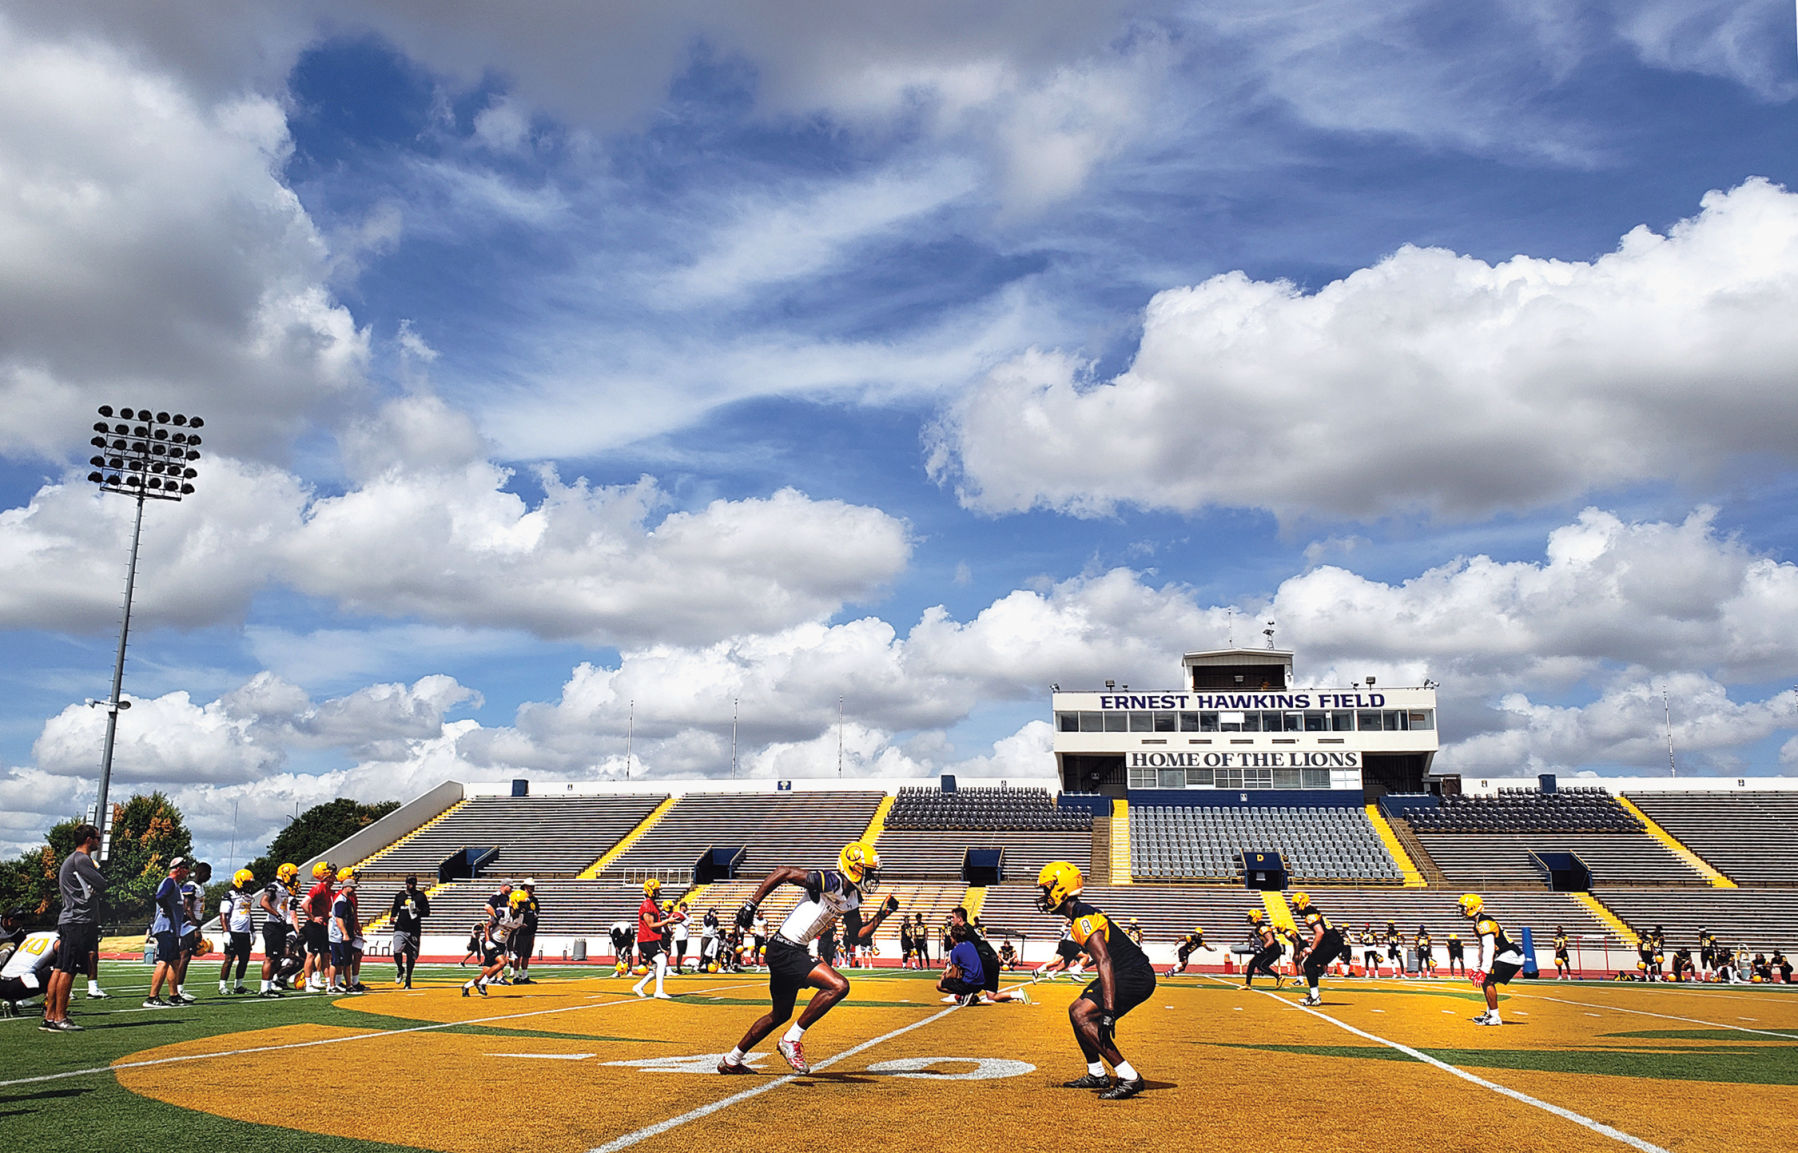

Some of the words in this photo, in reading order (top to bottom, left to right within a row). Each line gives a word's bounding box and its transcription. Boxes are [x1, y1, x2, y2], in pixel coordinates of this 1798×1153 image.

[1100, 694, 1189, 709] ERNEST
[1197, 694, 1311, 709] HAWKINS
[1318, 693, 1386, 708] FIELD
[1132, 752, 1200, 767] HOME
[1203, 752, 1235, 767] OF
[1237, 752, 1285, 767] THE
[1289, 752, 1357, 767] LIONS
[1256, 854, 1265, 862] D
[1080, 918, 1093, 936] 8
